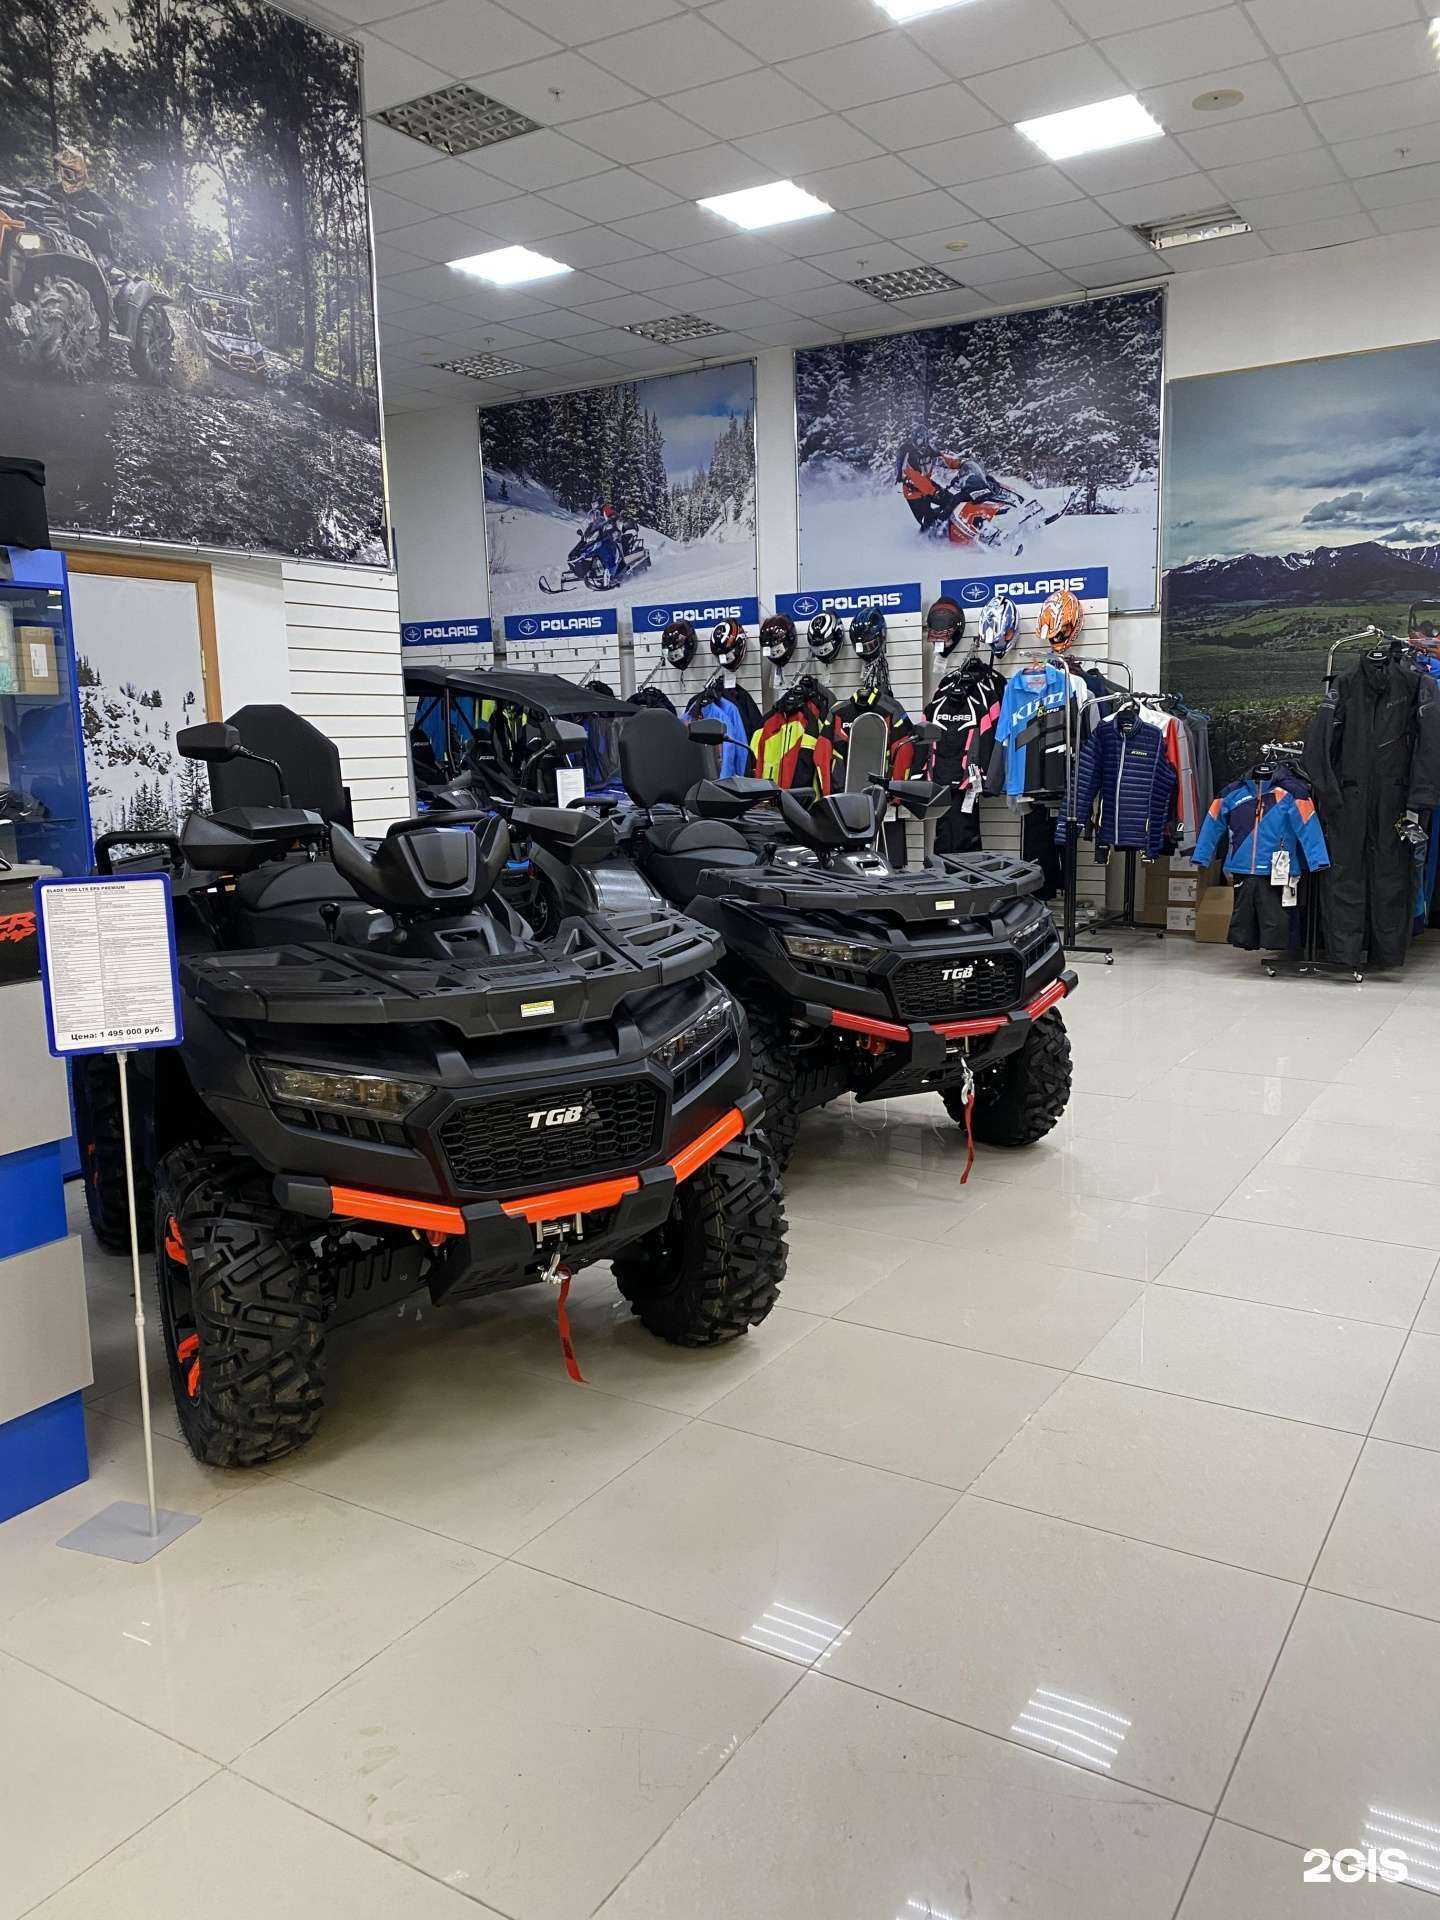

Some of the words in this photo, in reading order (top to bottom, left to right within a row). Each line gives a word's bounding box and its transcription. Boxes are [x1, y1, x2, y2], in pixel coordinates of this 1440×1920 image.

[994, 577, 1086, 597] POLARIS
[822, 592, 902, 610] POLARIS
[673, 605, 742, 623] POLARIS
[424, 625, 478, 639] POLARIS
[541, 616, 602, 632] POLARIS
[936, 713, 972, 722] POLARIS
[941, 967, 974, 980] TGB
[71, 1033, 98, 1041] Цена:
[107, 1029, 124, 1037] 495
[126, 1028, 142, 1036] 000
[144, 1026, 163, 1035] руб.
[528, 1106, 583, 1129] TGB
